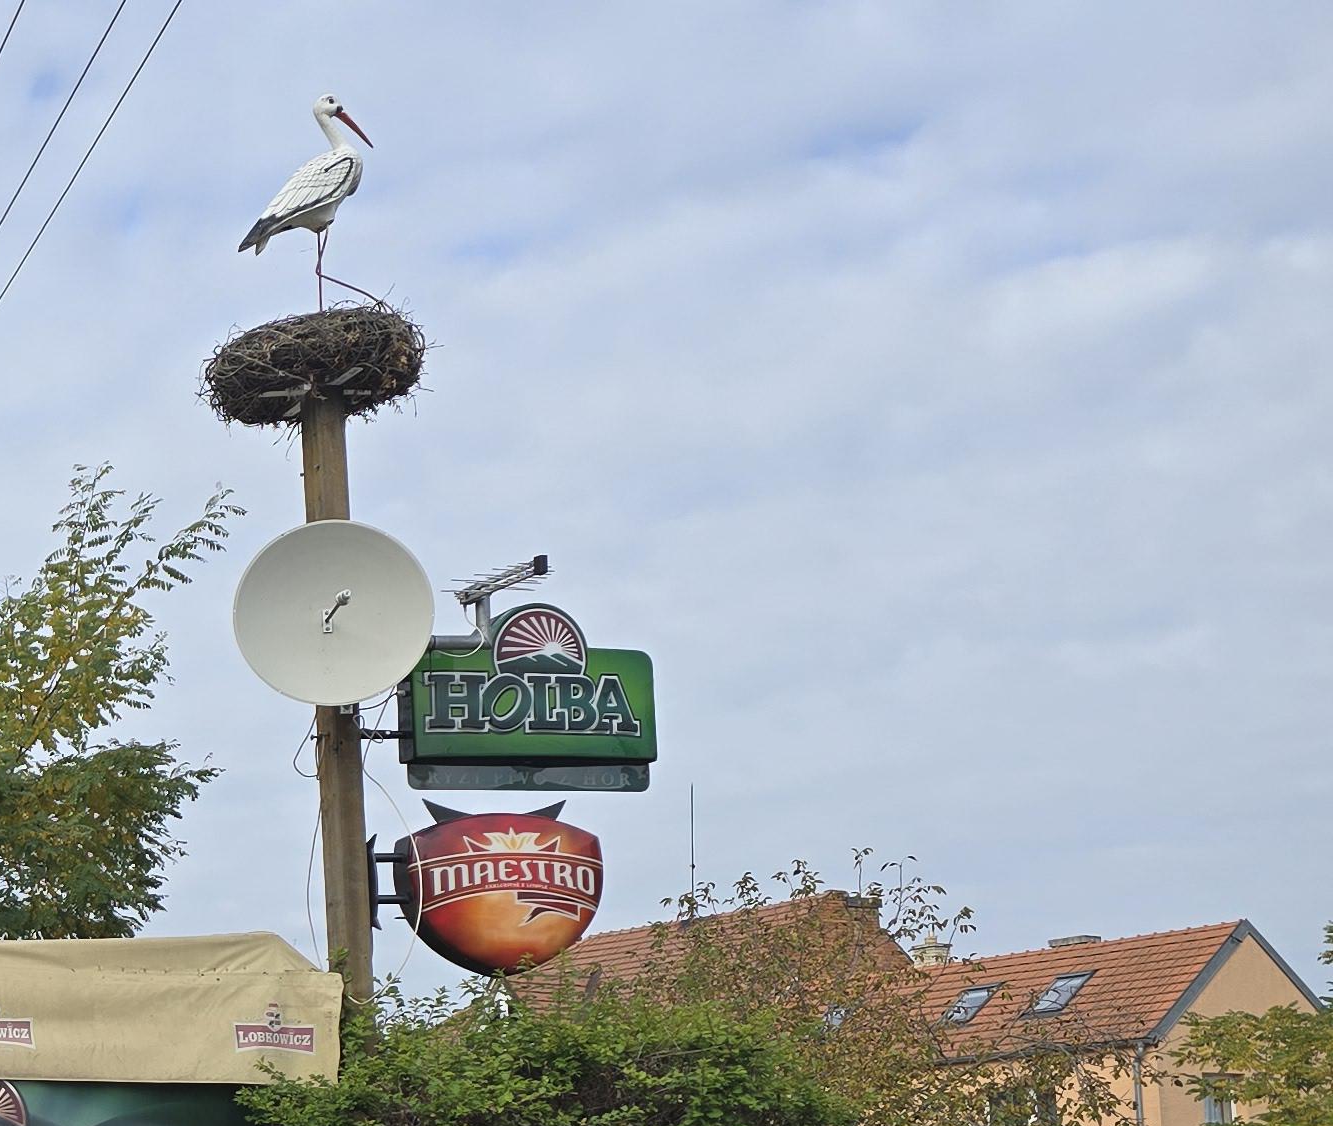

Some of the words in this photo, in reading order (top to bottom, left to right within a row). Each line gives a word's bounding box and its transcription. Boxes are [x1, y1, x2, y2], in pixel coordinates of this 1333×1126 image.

[424, 671, 641, 737] HOLBA
[583, 773, 632, 786] HOR
[430, 859, 596, 897] MAESTRO
[237, 1030, 311, 1046] LOBKOWICZ
